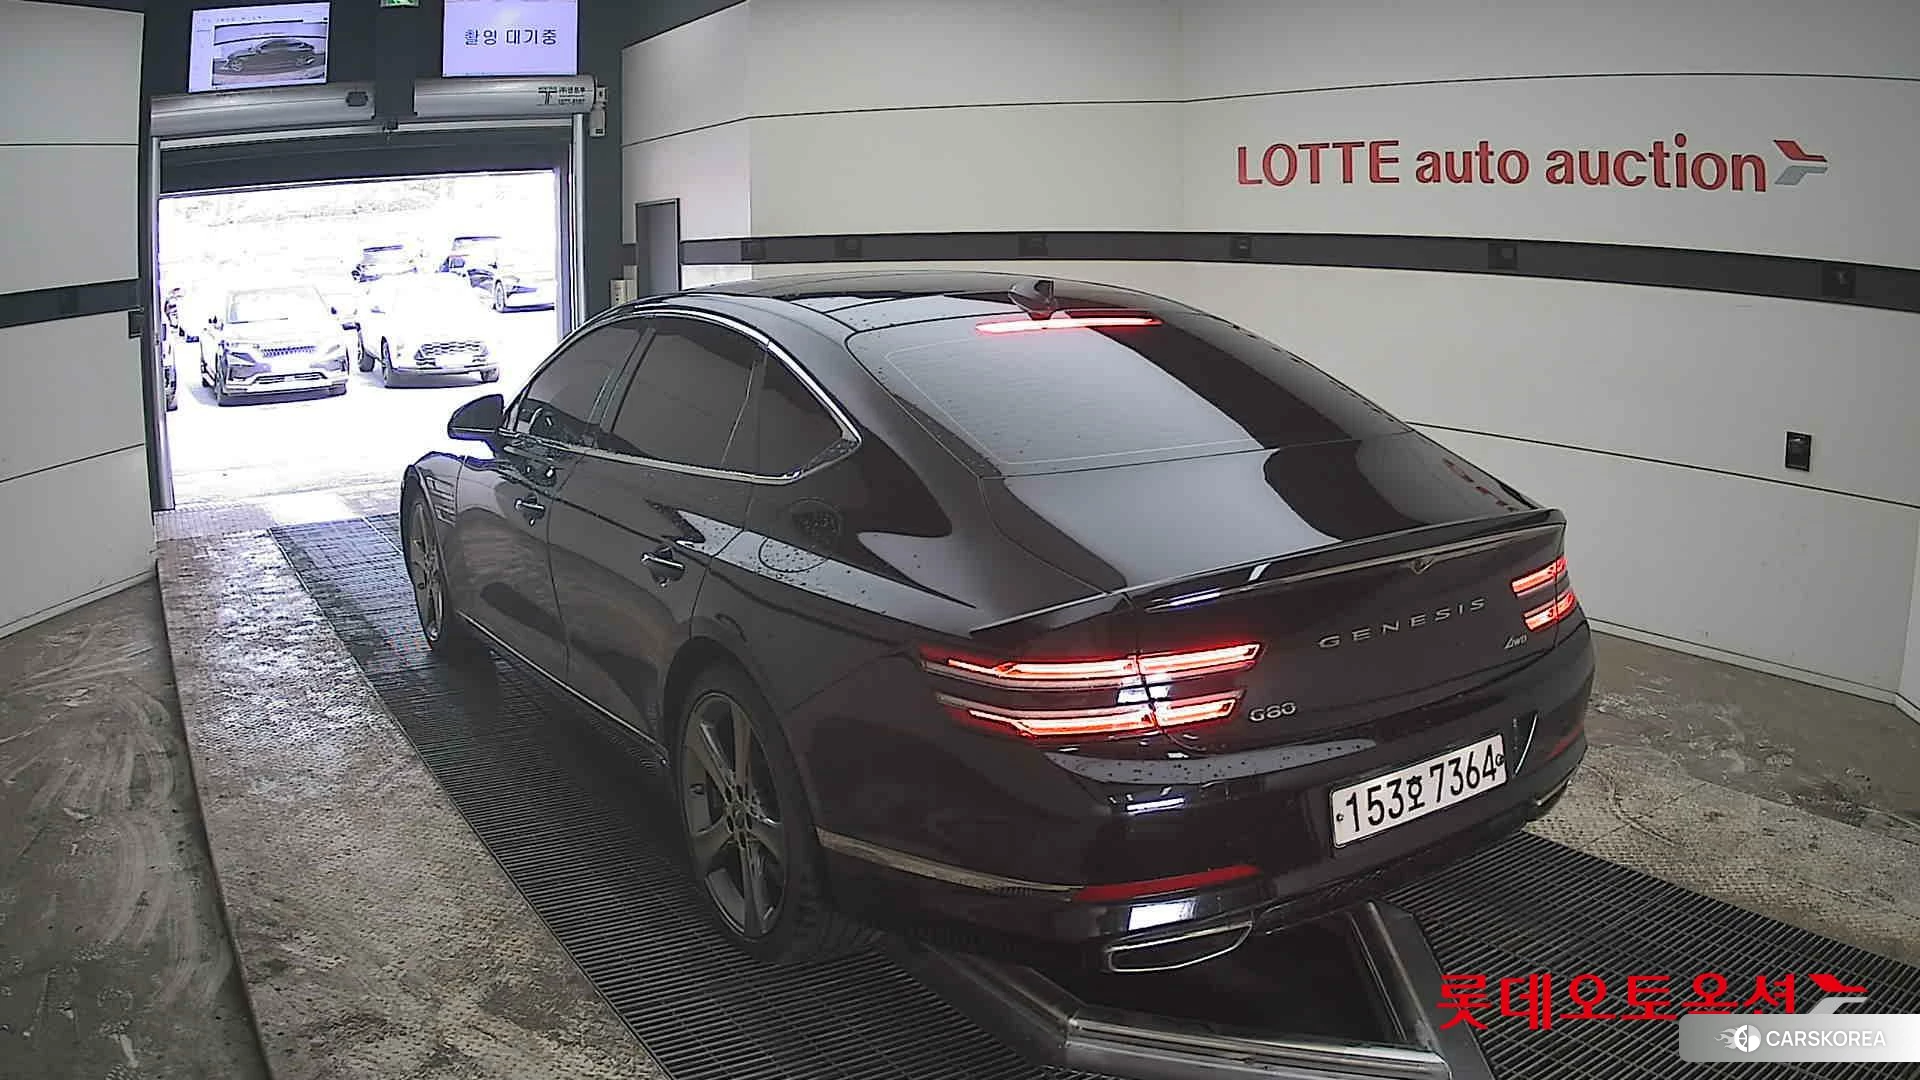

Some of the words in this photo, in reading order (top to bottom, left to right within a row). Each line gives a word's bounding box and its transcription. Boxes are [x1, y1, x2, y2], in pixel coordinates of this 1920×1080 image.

[505, 29, 557, 46] 대기중
[1237, 139, 1400, 186] LOTTE
[1415, 140, 1530, 185] auto
[1545, 133, 1767, 192] auction
[1318, 598, 1487, 648] GENESIS
